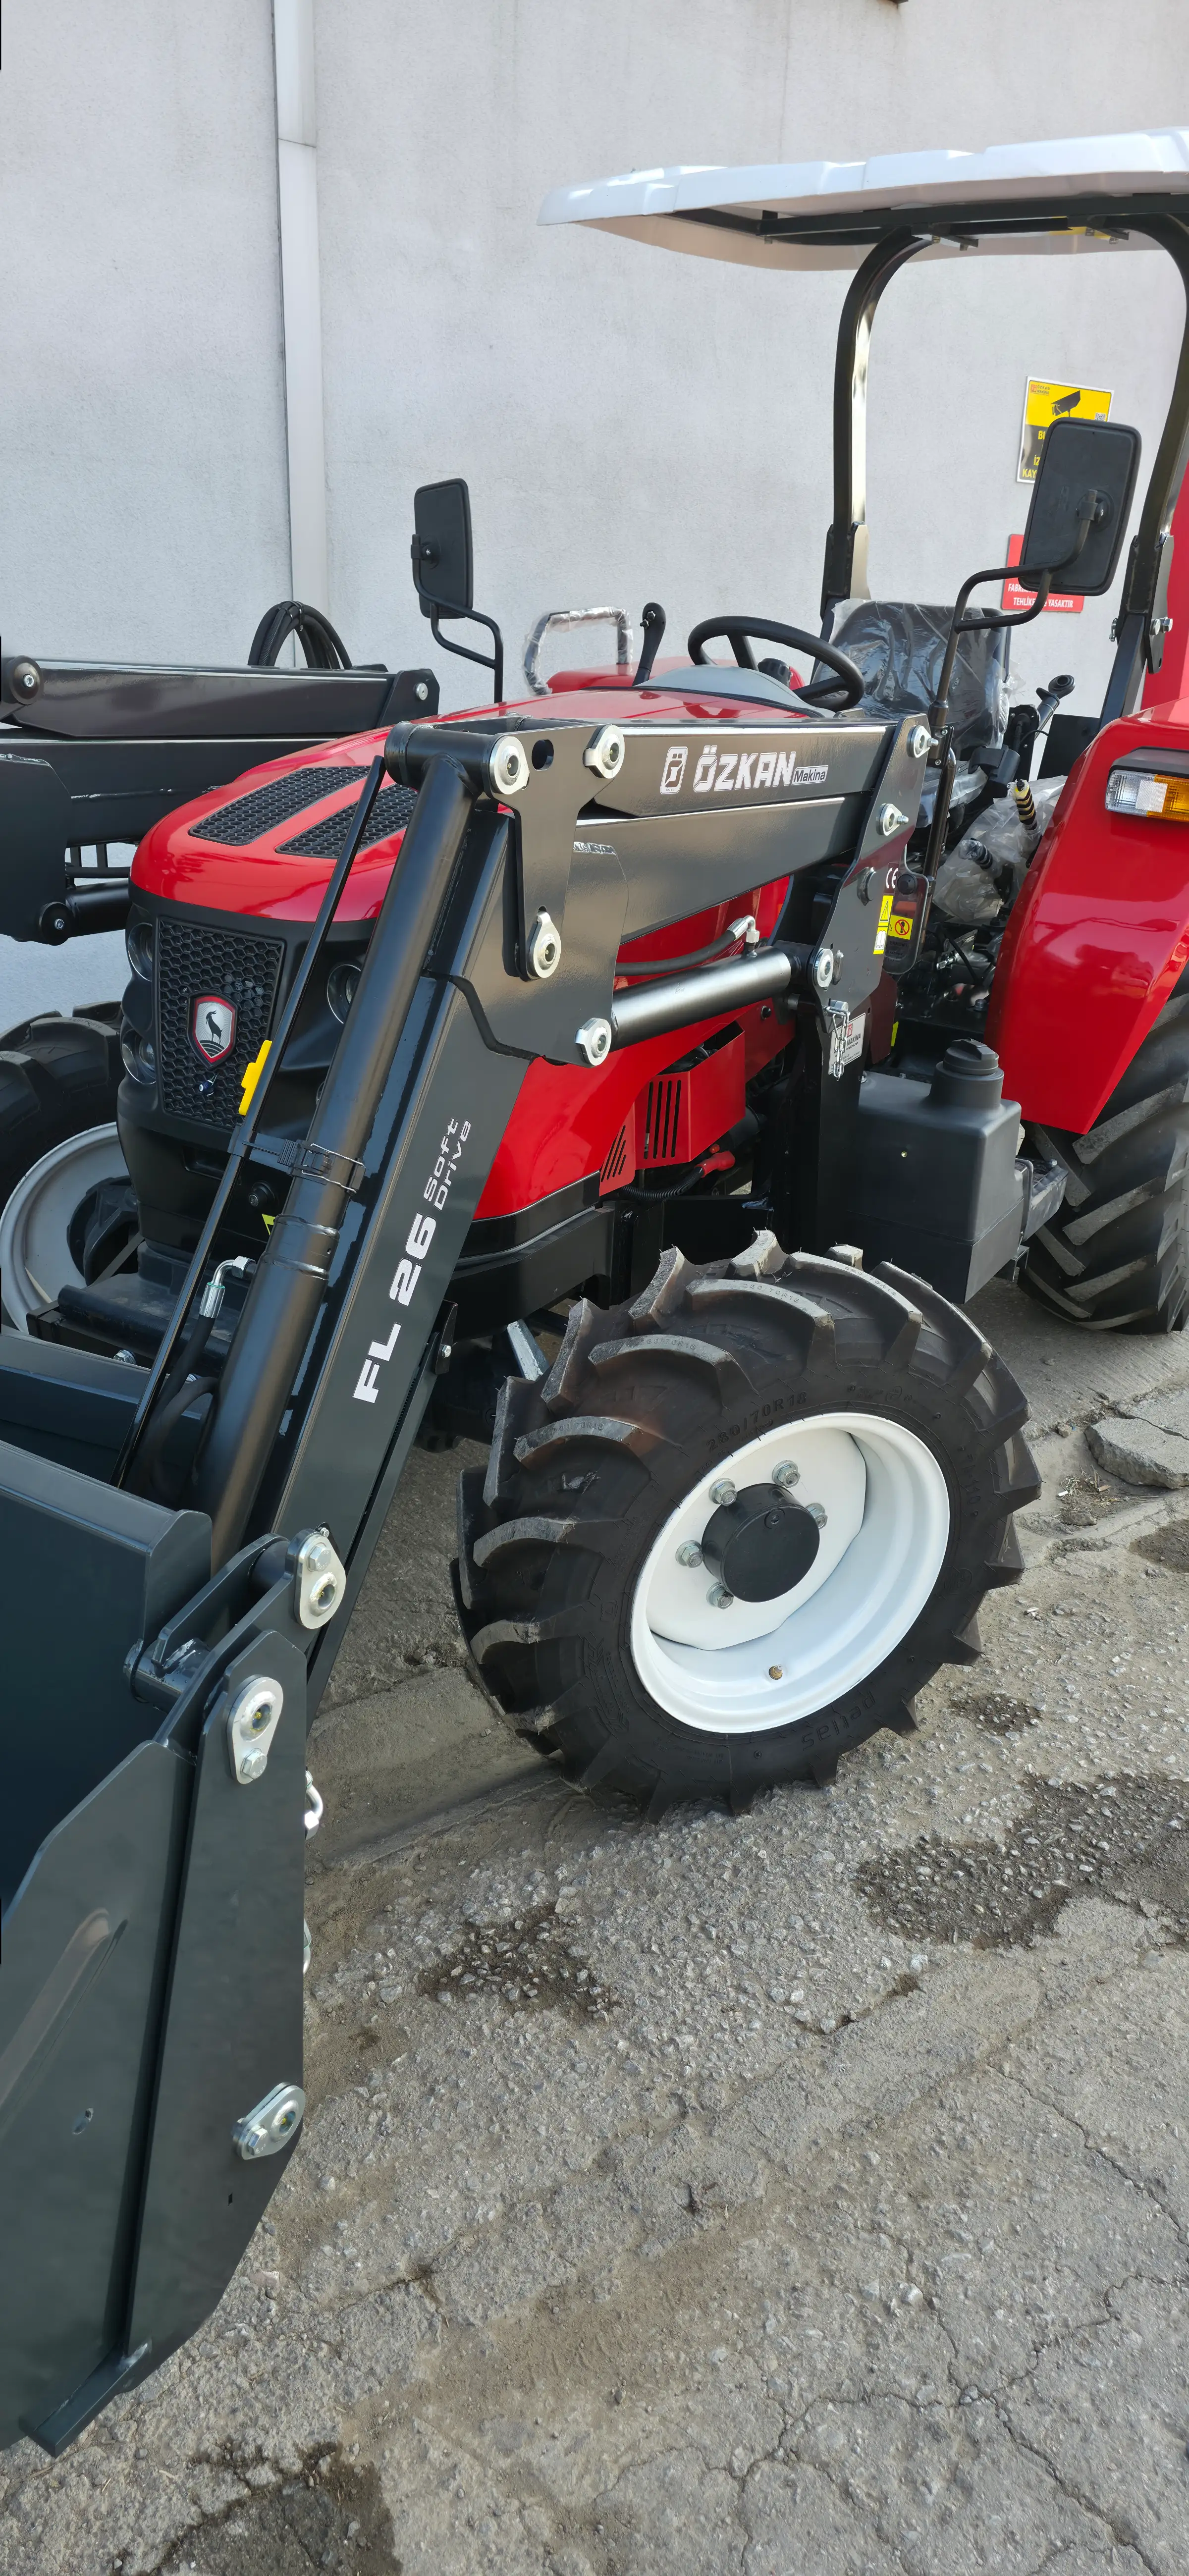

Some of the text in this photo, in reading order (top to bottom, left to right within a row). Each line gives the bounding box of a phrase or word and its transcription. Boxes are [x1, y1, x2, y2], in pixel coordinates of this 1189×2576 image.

[1048, 599, 1074, 608] YASAKTIR
[693, 745, 796, 793] ÖZKAN
[793, 769, 826, 782] Makina
[424, 1117, 458, 1202] Soft
[433, 1119, 471, 1211] Drive
[352, 1212, 436, 1403] FL 26
[705, 1391, 808, 1451] 280/70R18
[801, 1690, 877, 1751] petlas
